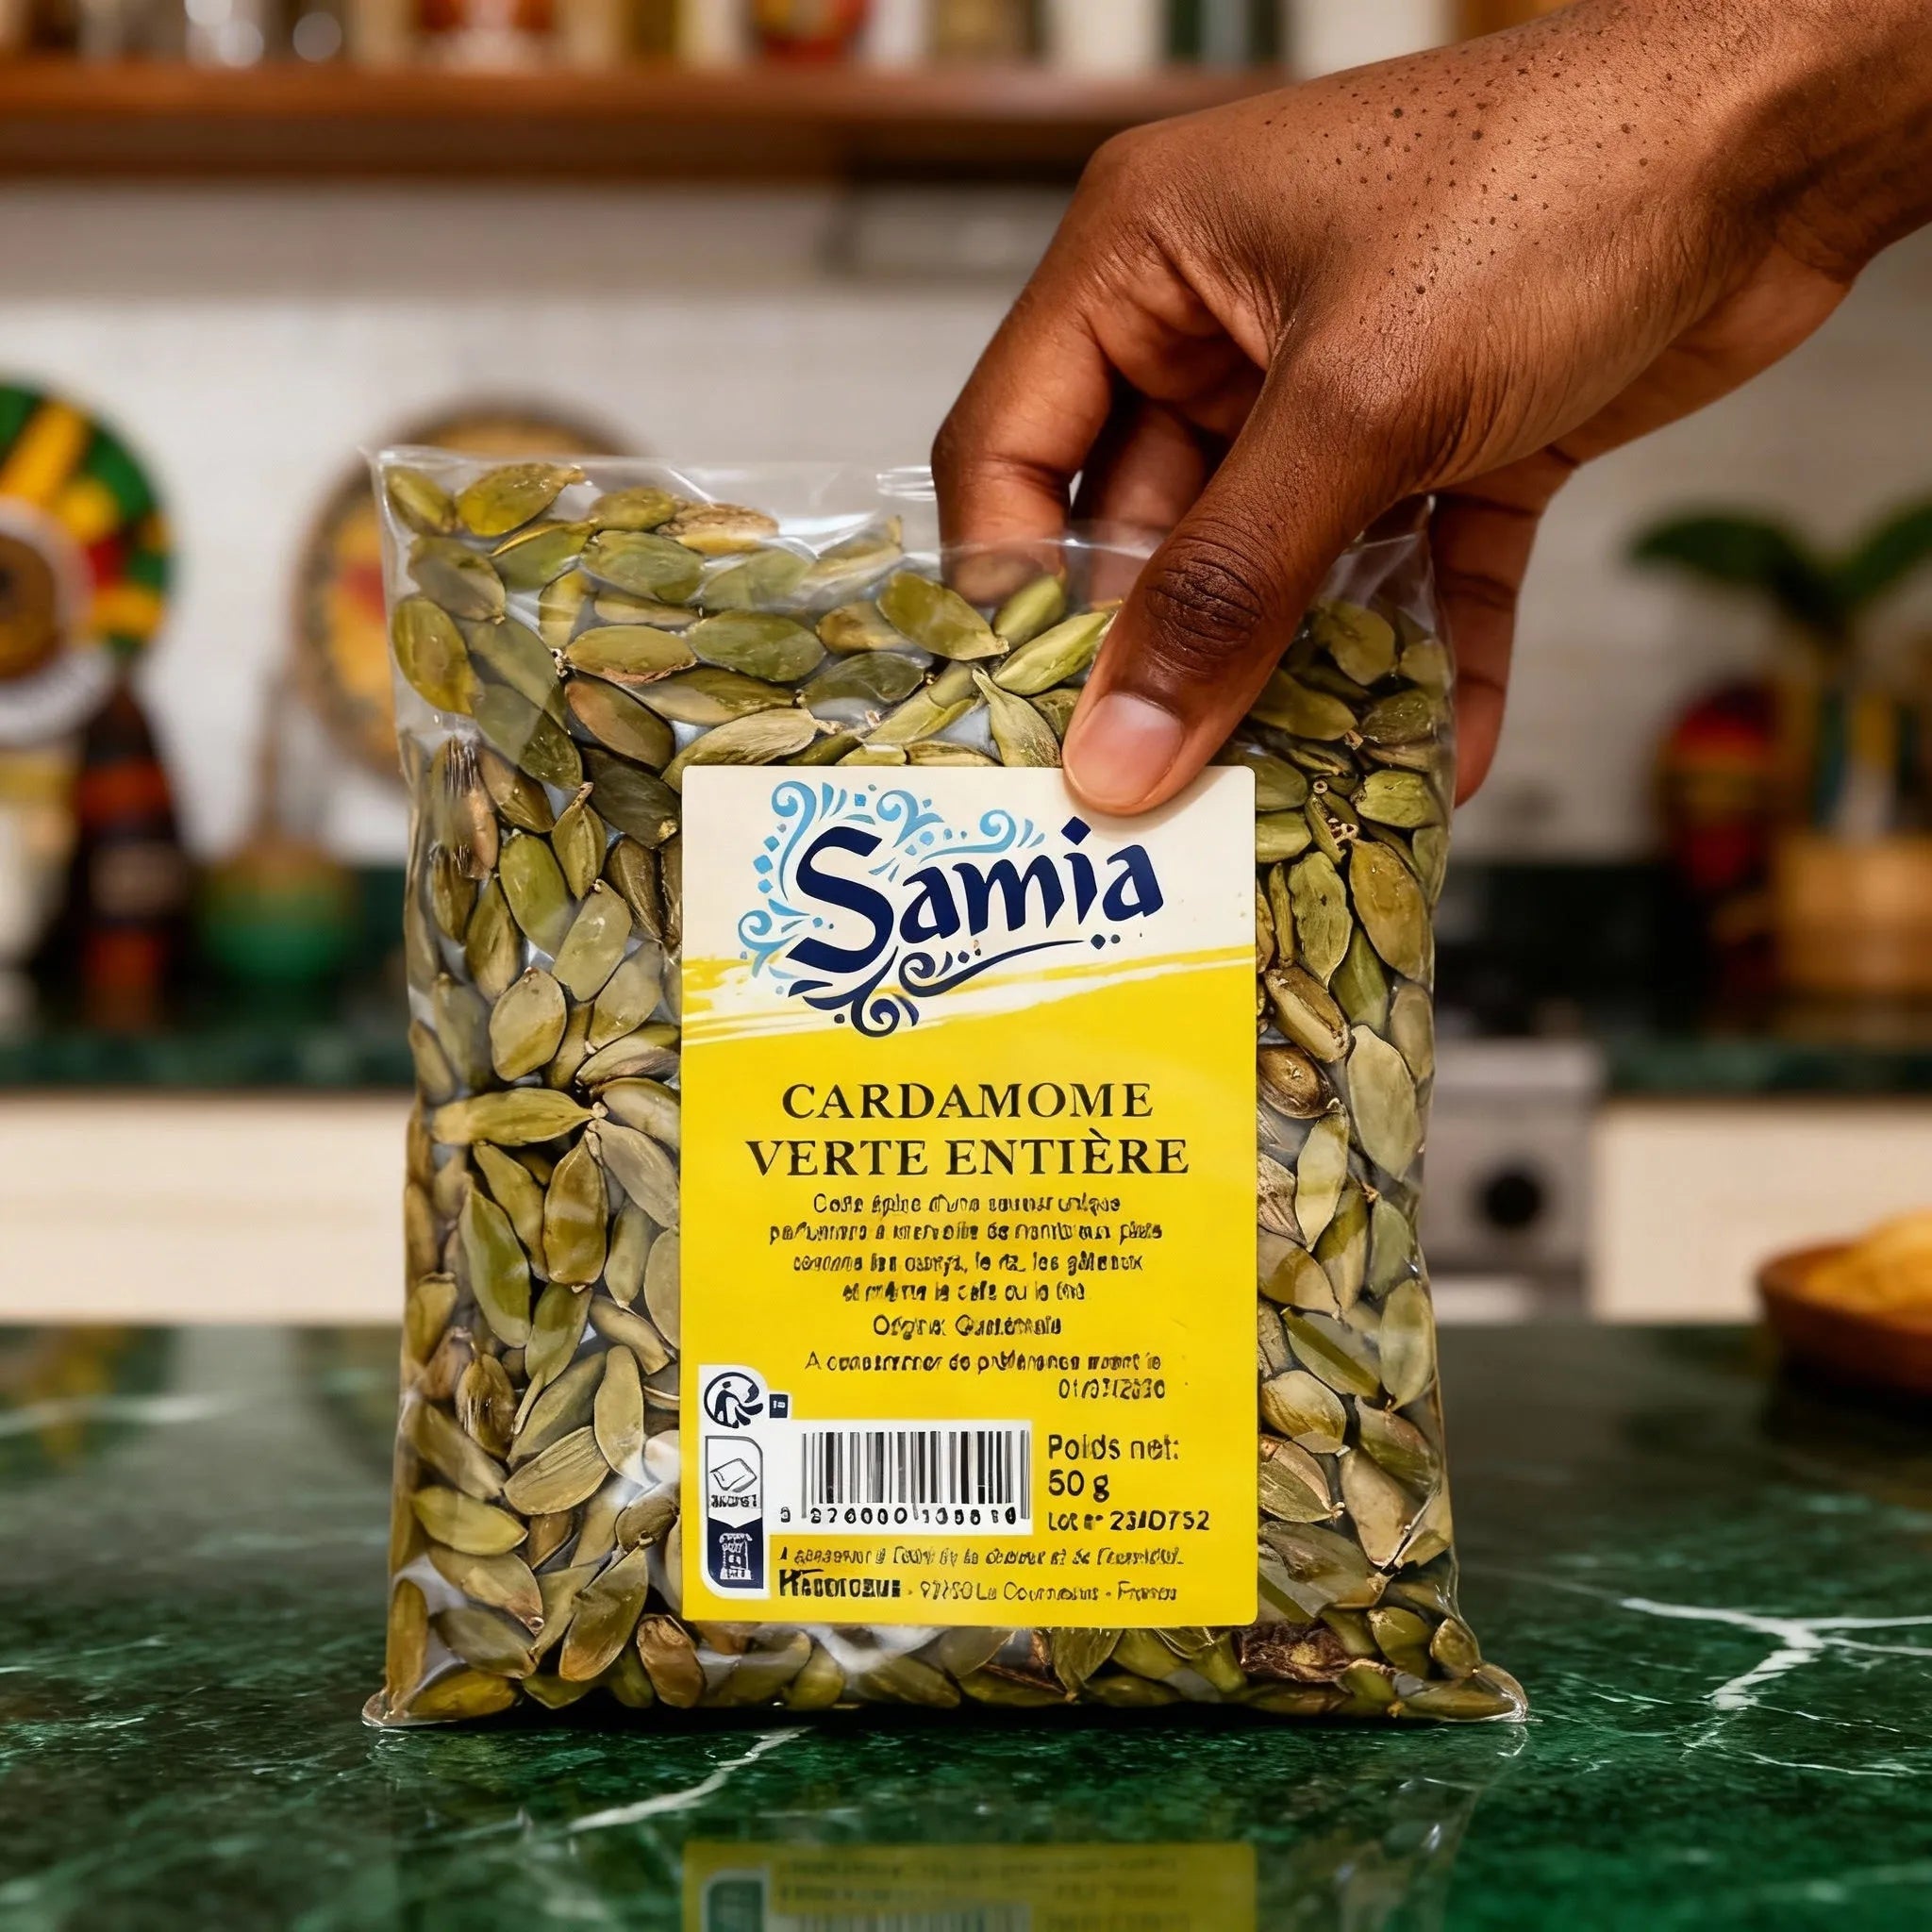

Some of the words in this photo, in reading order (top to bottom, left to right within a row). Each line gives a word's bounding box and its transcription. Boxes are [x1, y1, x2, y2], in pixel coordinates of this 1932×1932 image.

[787, 816, 1163, 974] Samia
[783, 1083, 1152, 1119] CARDAMOME
[746, 1141, 927, 1176] VERTE
[945, 1128, 1189, 1175] ENTIÈRE
[1048, 1434, 1121, 1460] Poids
[1048, 1468, 1085, 1497] 50
[1092, 1474, 1110, 1504] g
